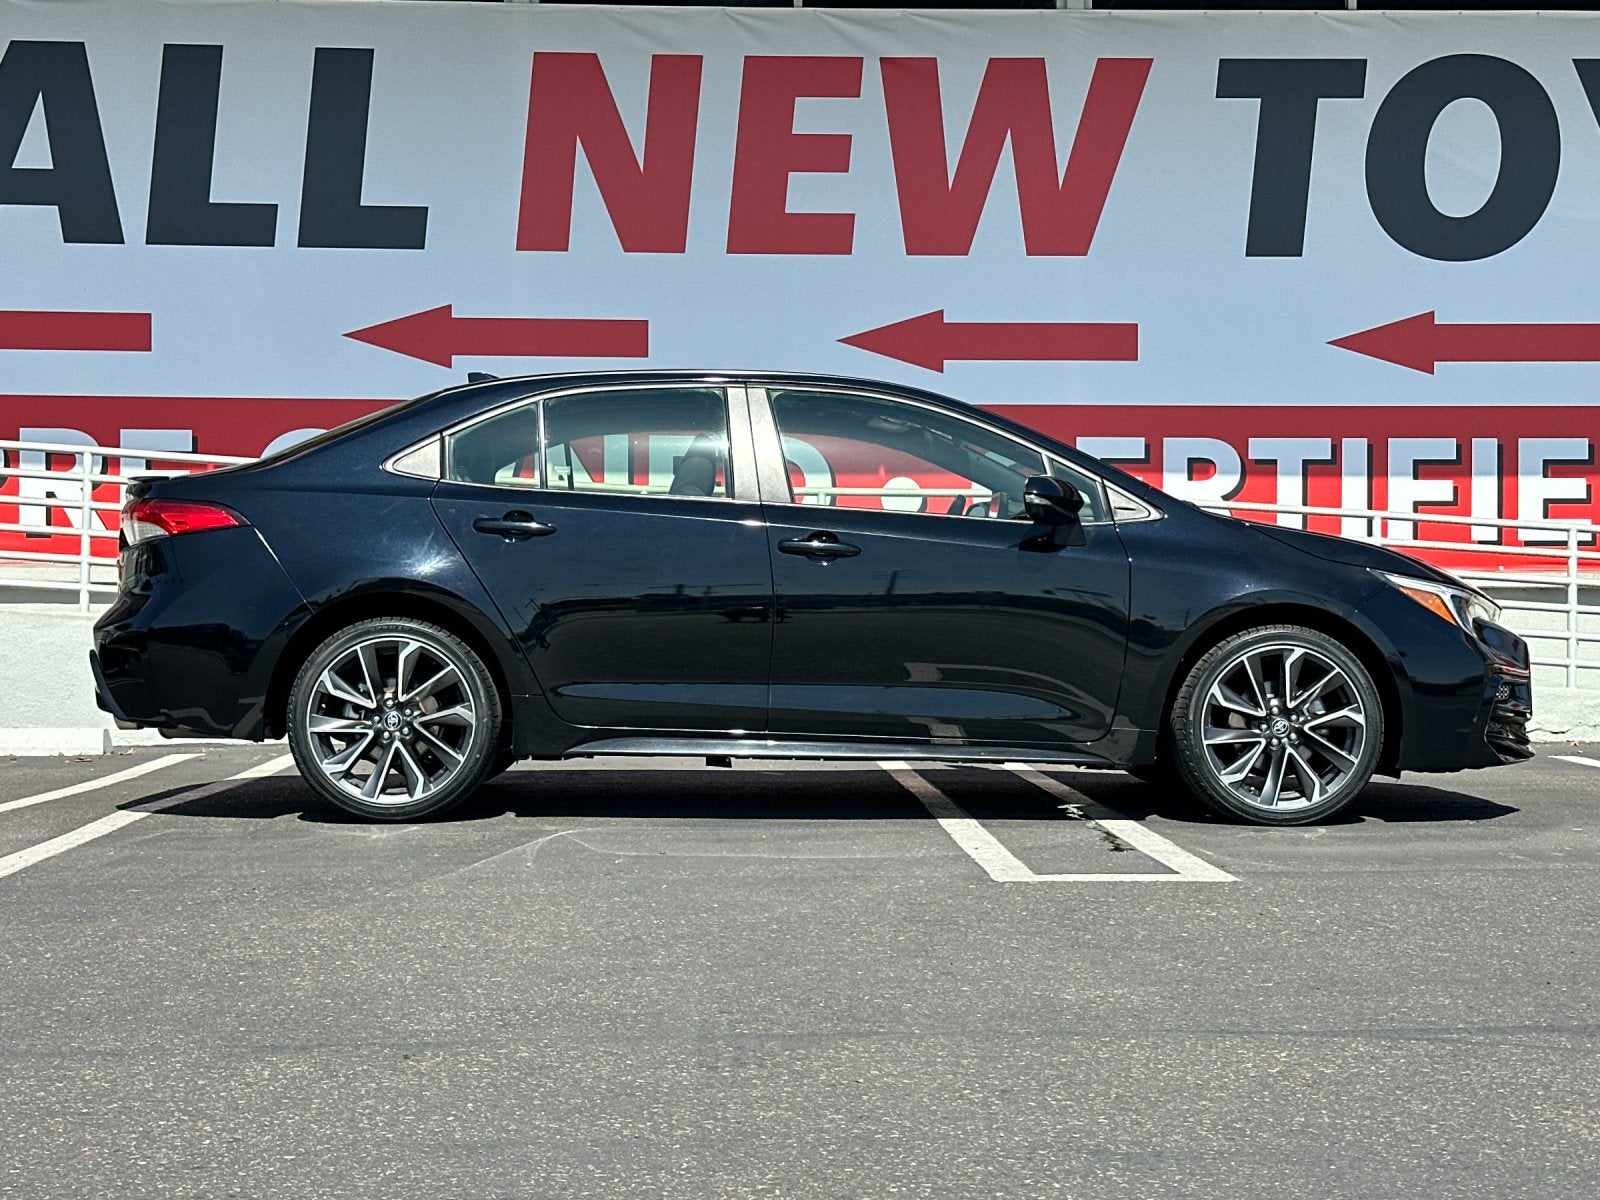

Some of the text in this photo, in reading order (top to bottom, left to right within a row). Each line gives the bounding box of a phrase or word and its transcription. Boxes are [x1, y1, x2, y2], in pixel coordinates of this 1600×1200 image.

[0, 40, 1600, 262] ALL NEW TO
